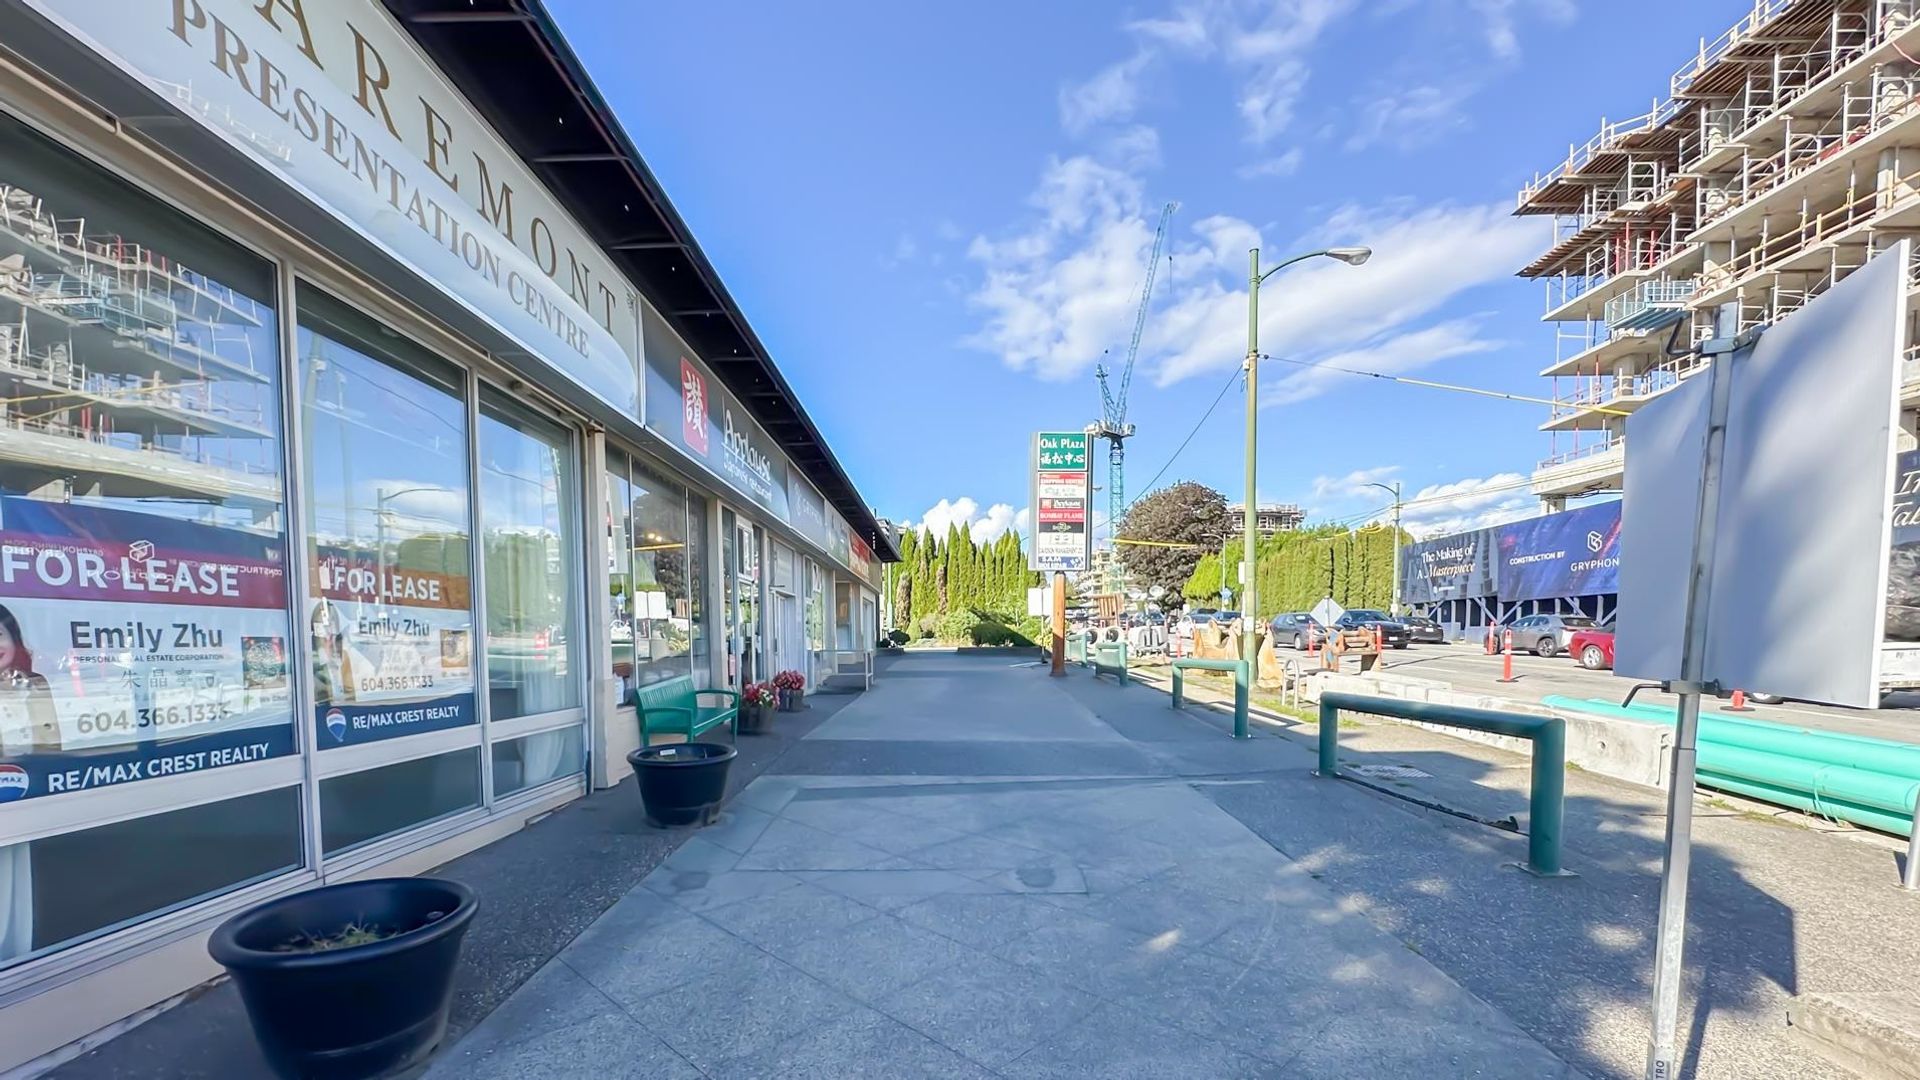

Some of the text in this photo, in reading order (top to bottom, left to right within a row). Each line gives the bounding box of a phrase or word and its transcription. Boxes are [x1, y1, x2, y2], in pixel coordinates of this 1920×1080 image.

[168, 0, 590, 359] PRESENTATION CENTRE
[1040, 437, 1058, 449] Oak
[1421, 542, 1475, 564] The Making of
[1509, 551, 1566, 566] CONSTRUCTION BY
[2, 549, 241, 598] FOR LEASE
[1570, 557, 1620, 573] GRYPHON
[334, 566, 441, 602] FOR LEASE
[70, 620, 223, 653] Emily Zhu
[358, 616, 430, 639] Emily Zhu
[146, 654, 174, 663] ESTATE
[175, 653, 224, 662] CORPORATION
[361, 675, 434, 692] 604.366.1333
[353, 711, 394, 730] RE/MAX
[396, 709, 425, 724] CREST
[426, 705, 460, 720] REALTY
[48, 743, 269, 793] RE/MAX CREST REALTY
